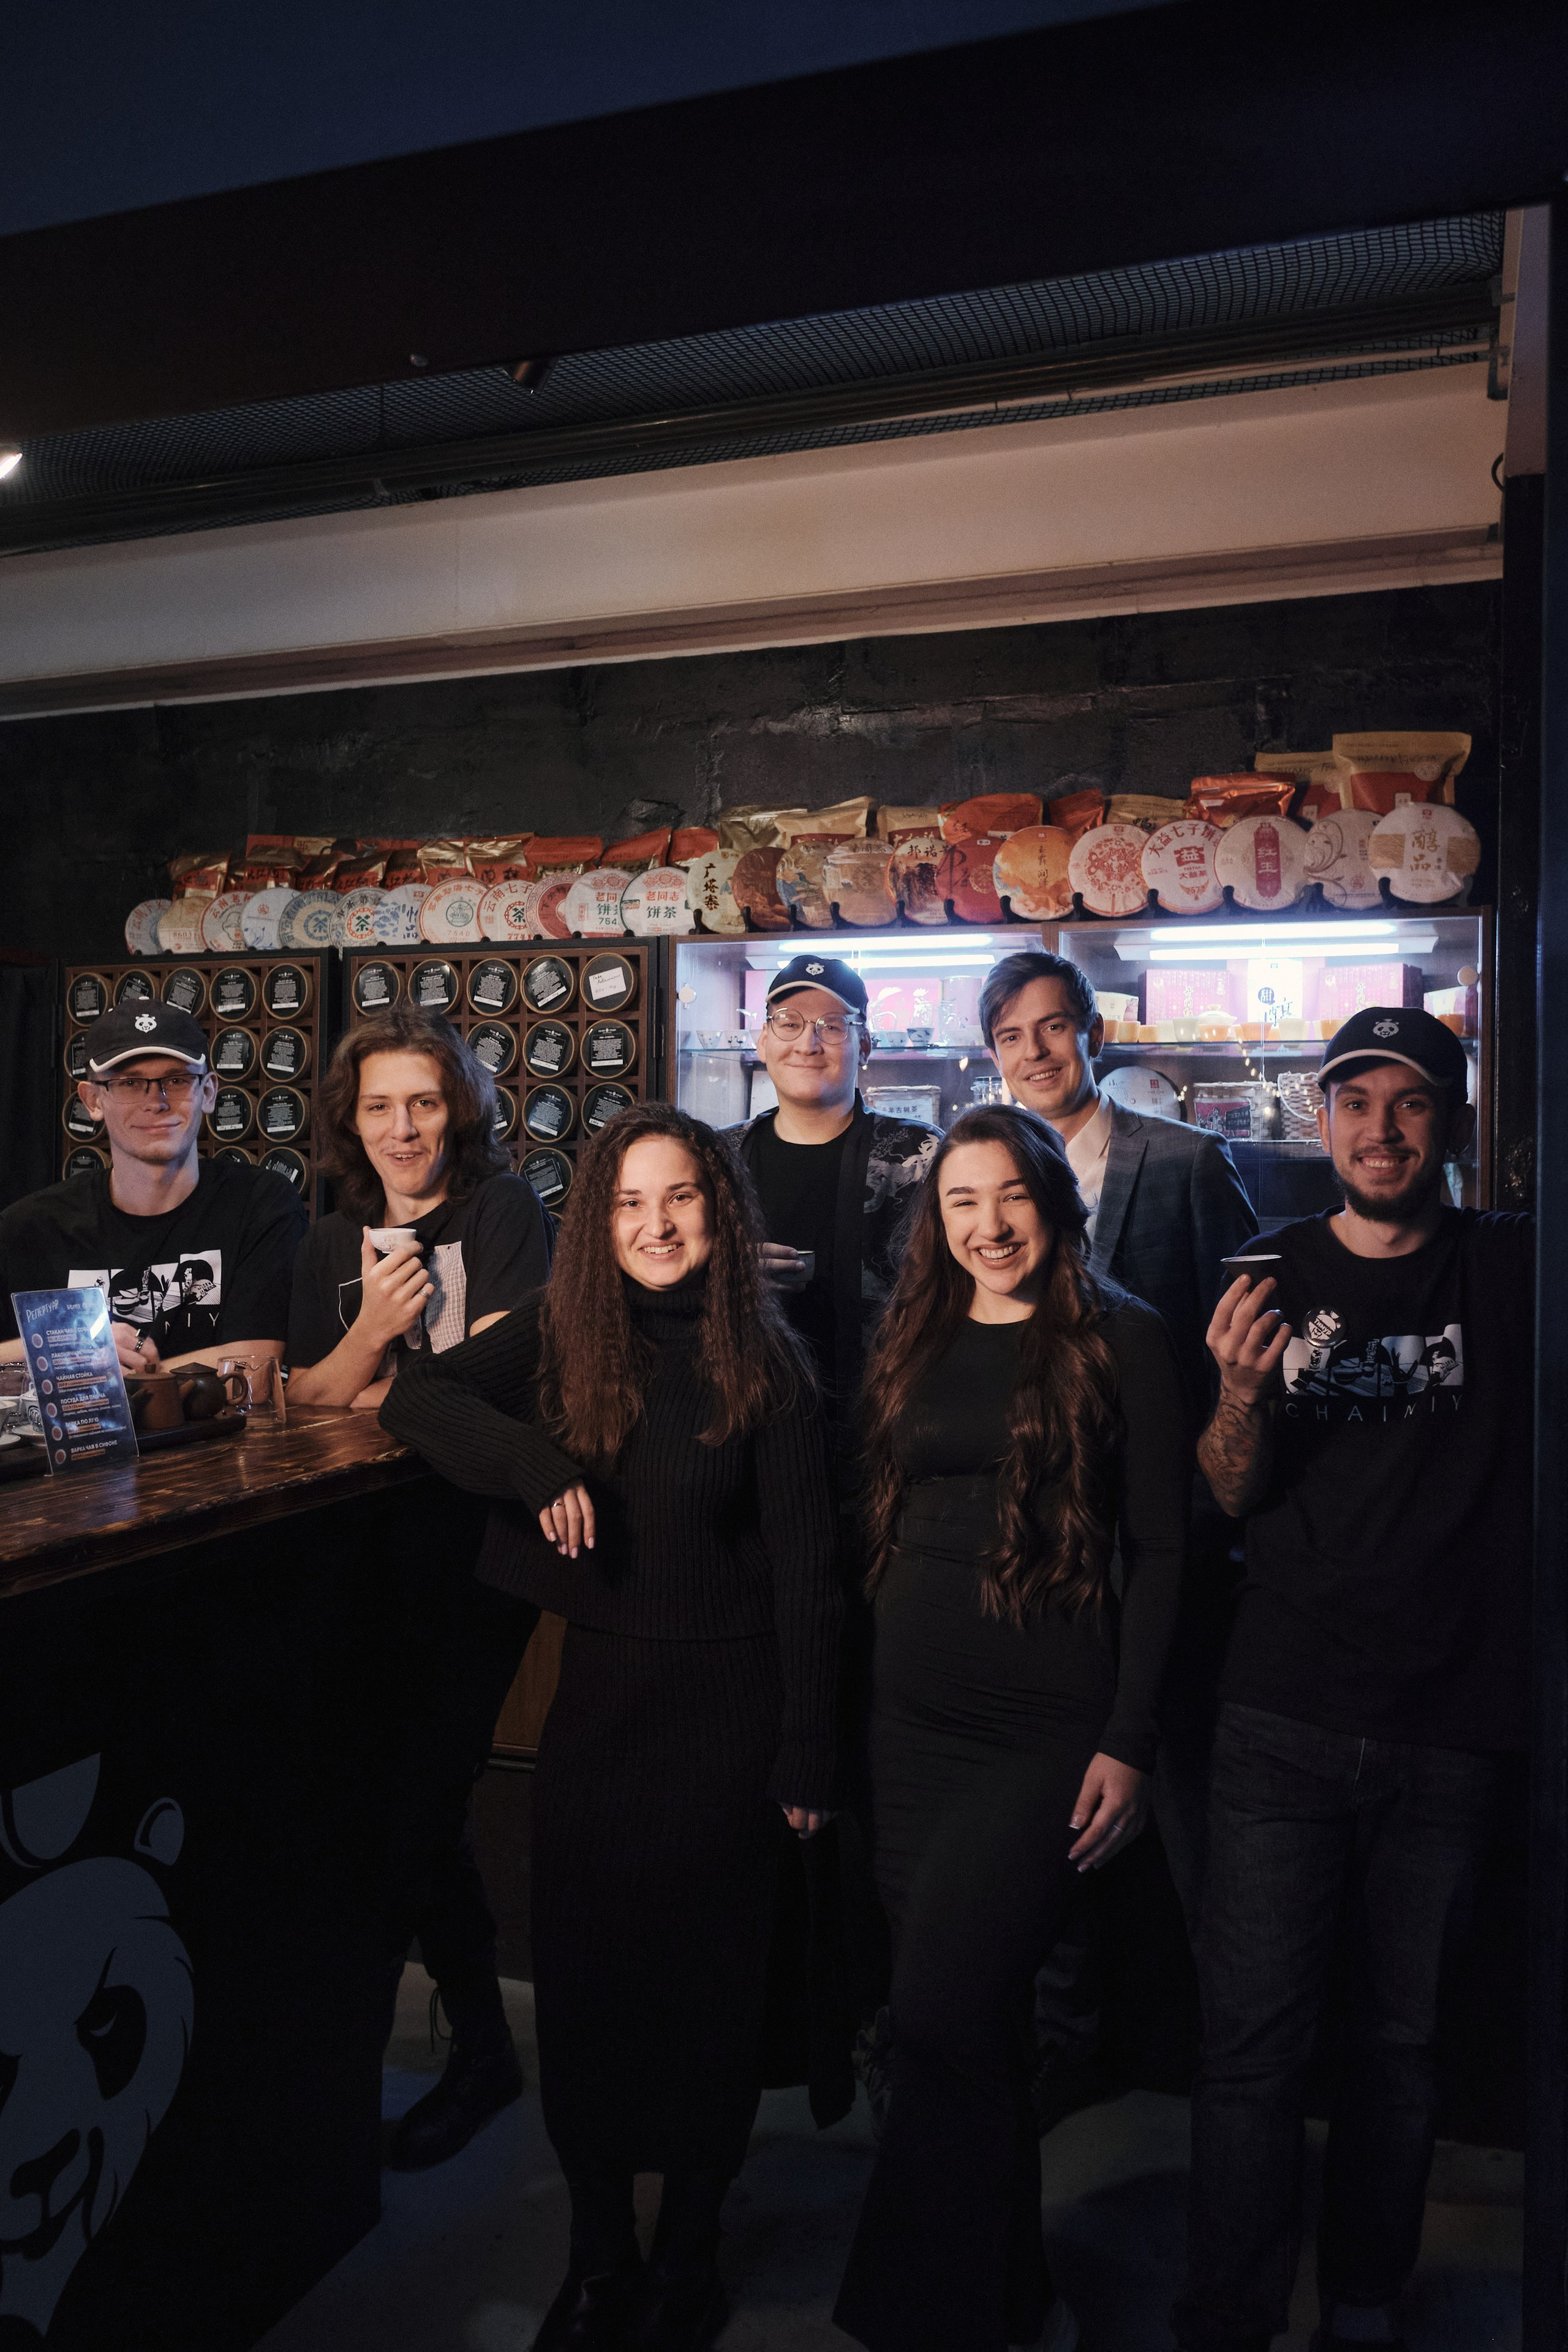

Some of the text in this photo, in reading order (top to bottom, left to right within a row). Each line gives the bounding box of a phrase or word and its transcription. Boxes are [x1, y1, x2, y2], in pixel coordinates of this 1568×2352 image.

[595, 892, 617, 903] 老同
[646, 891, 680, 902] 老同志
[647, 906, 677, 919] 饼茶
[1286, 1395, 1463, 1422] CHAINIY
[99, 1439, 118, 1448] СИФОНЕ
